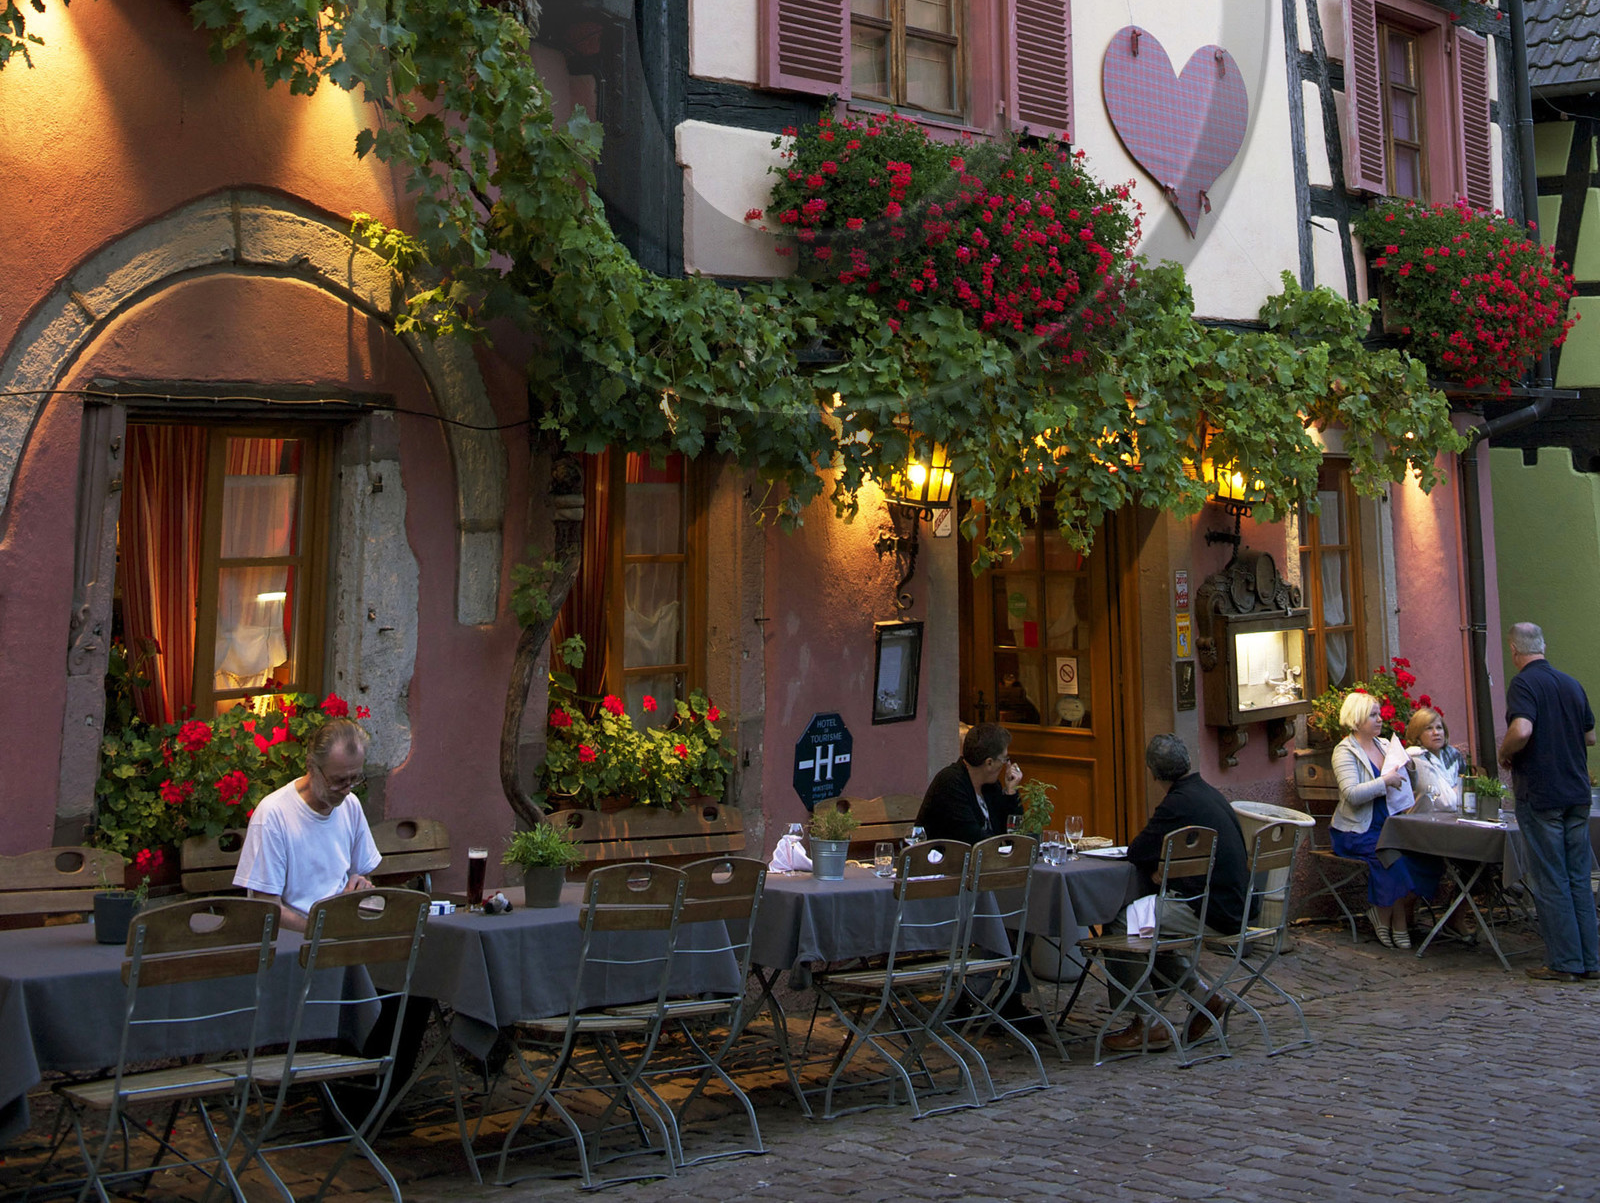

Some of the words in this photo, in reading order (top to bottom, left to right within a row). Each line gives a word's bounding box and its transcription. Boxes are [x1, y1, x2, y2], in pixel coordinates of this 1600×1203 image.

[817, 719, 837, 728] HOTEL
[811, 733, 842, 744] TOURISME
[814, 744, 834, 783] H
